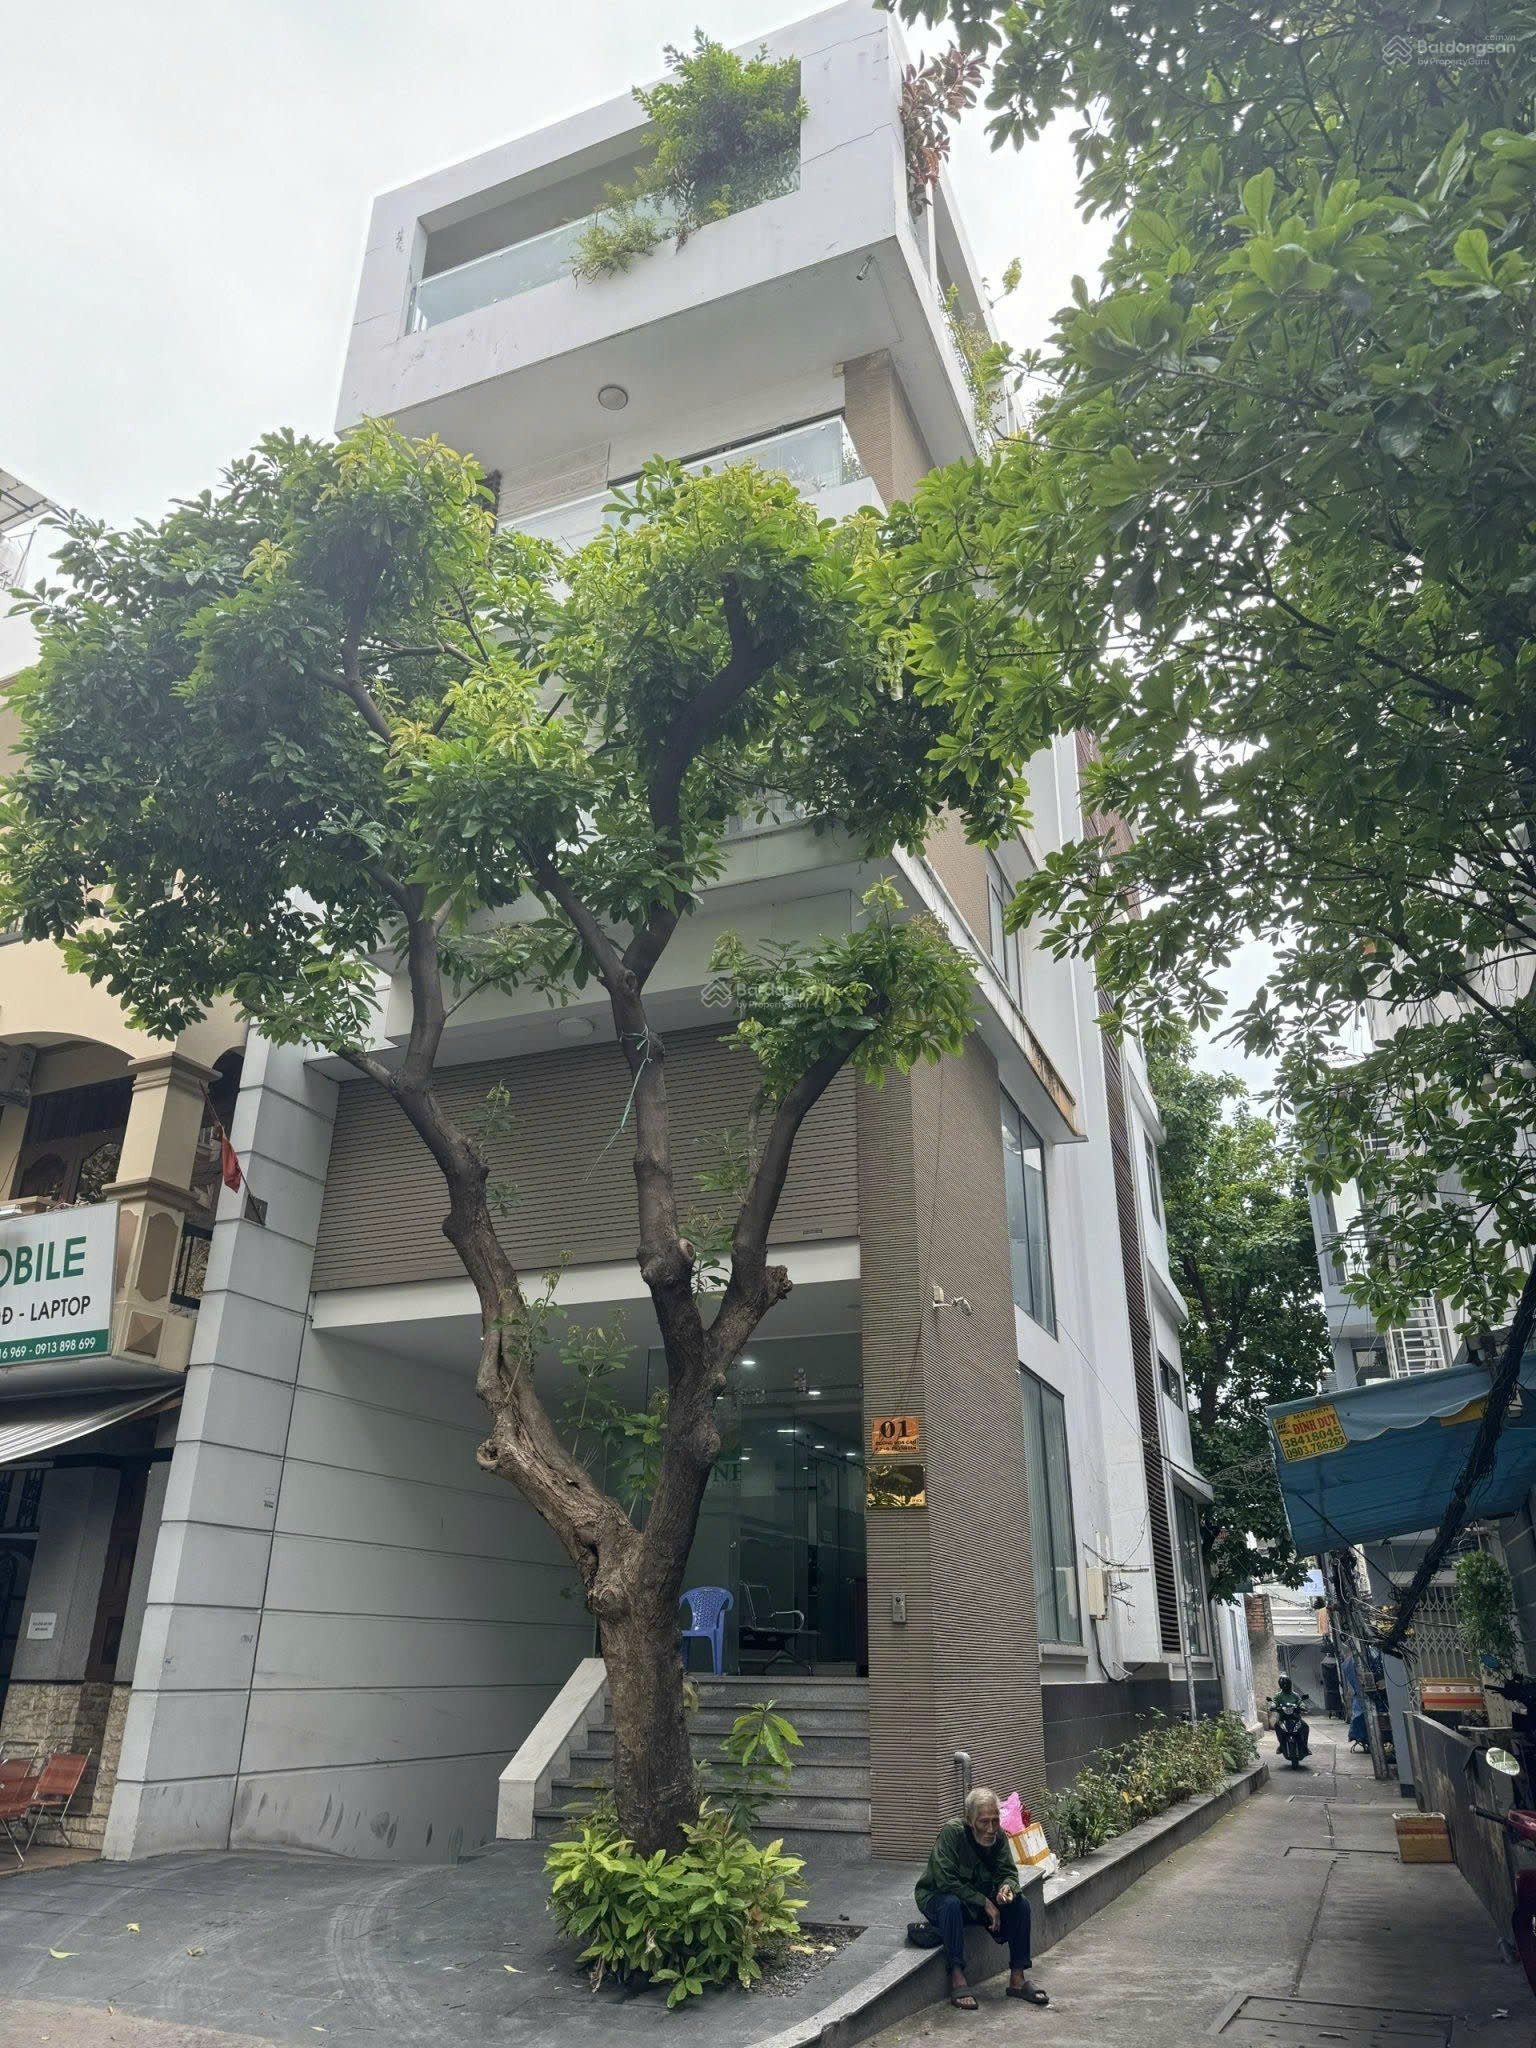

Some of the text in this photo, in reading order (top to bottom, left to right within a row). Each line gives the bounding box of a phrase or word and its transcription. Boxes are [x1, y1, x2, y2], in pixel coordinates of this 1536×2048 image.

[30, 1295, 91, 1321] LAPTOP
[10, 1345, 27, 1358] 969
[35, 1340, 57, 1355] 0913
[60, 1338, 76, 1351] 898
[79, 1337, 96, 1349] 699
[880, 1420, 910, 1438] 01
